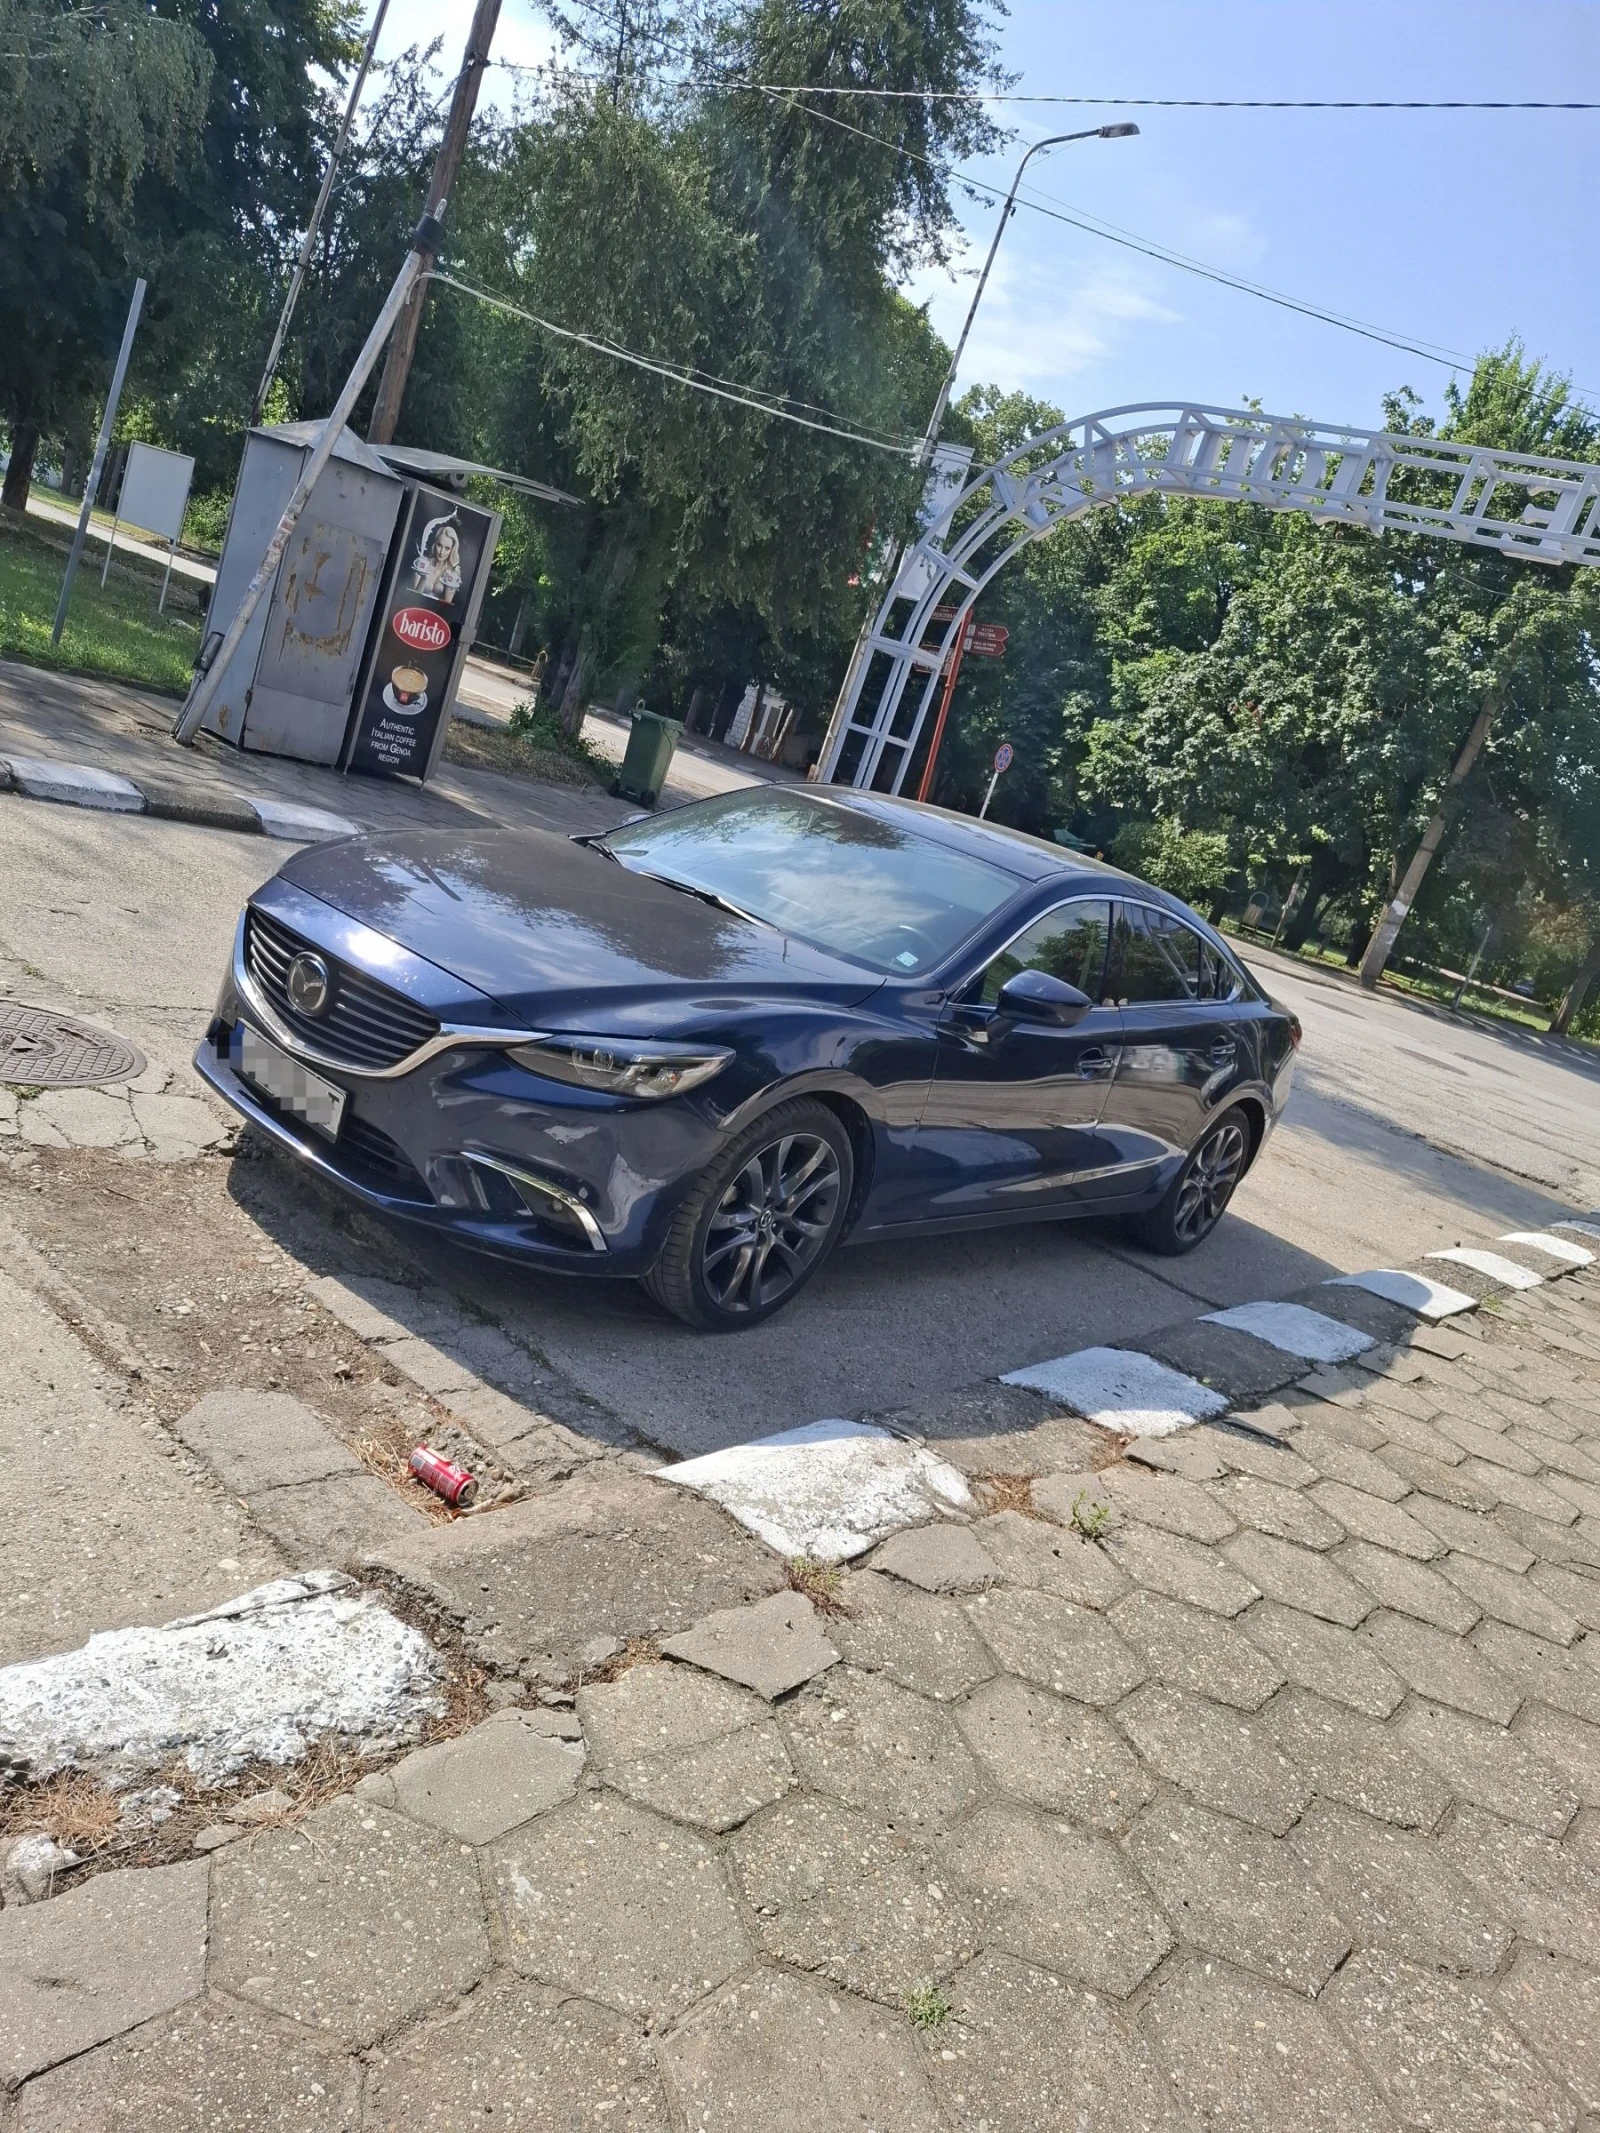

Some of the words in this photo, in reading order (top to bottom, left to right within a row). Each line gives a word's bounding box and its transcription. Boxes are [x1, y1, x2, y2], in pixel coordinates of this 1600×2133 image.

[400, 612, 445, 645] baristo
[380, 718, 415, 735] AUTHENTIC
[371, 727, 395, 741] ITALIAN
[395, 735, 417, 747] COFFEE
[370, 740, 389, 752] FROM
[389, 743, 411, 756] GENOA
[377, 753, 400, 764] REGION
